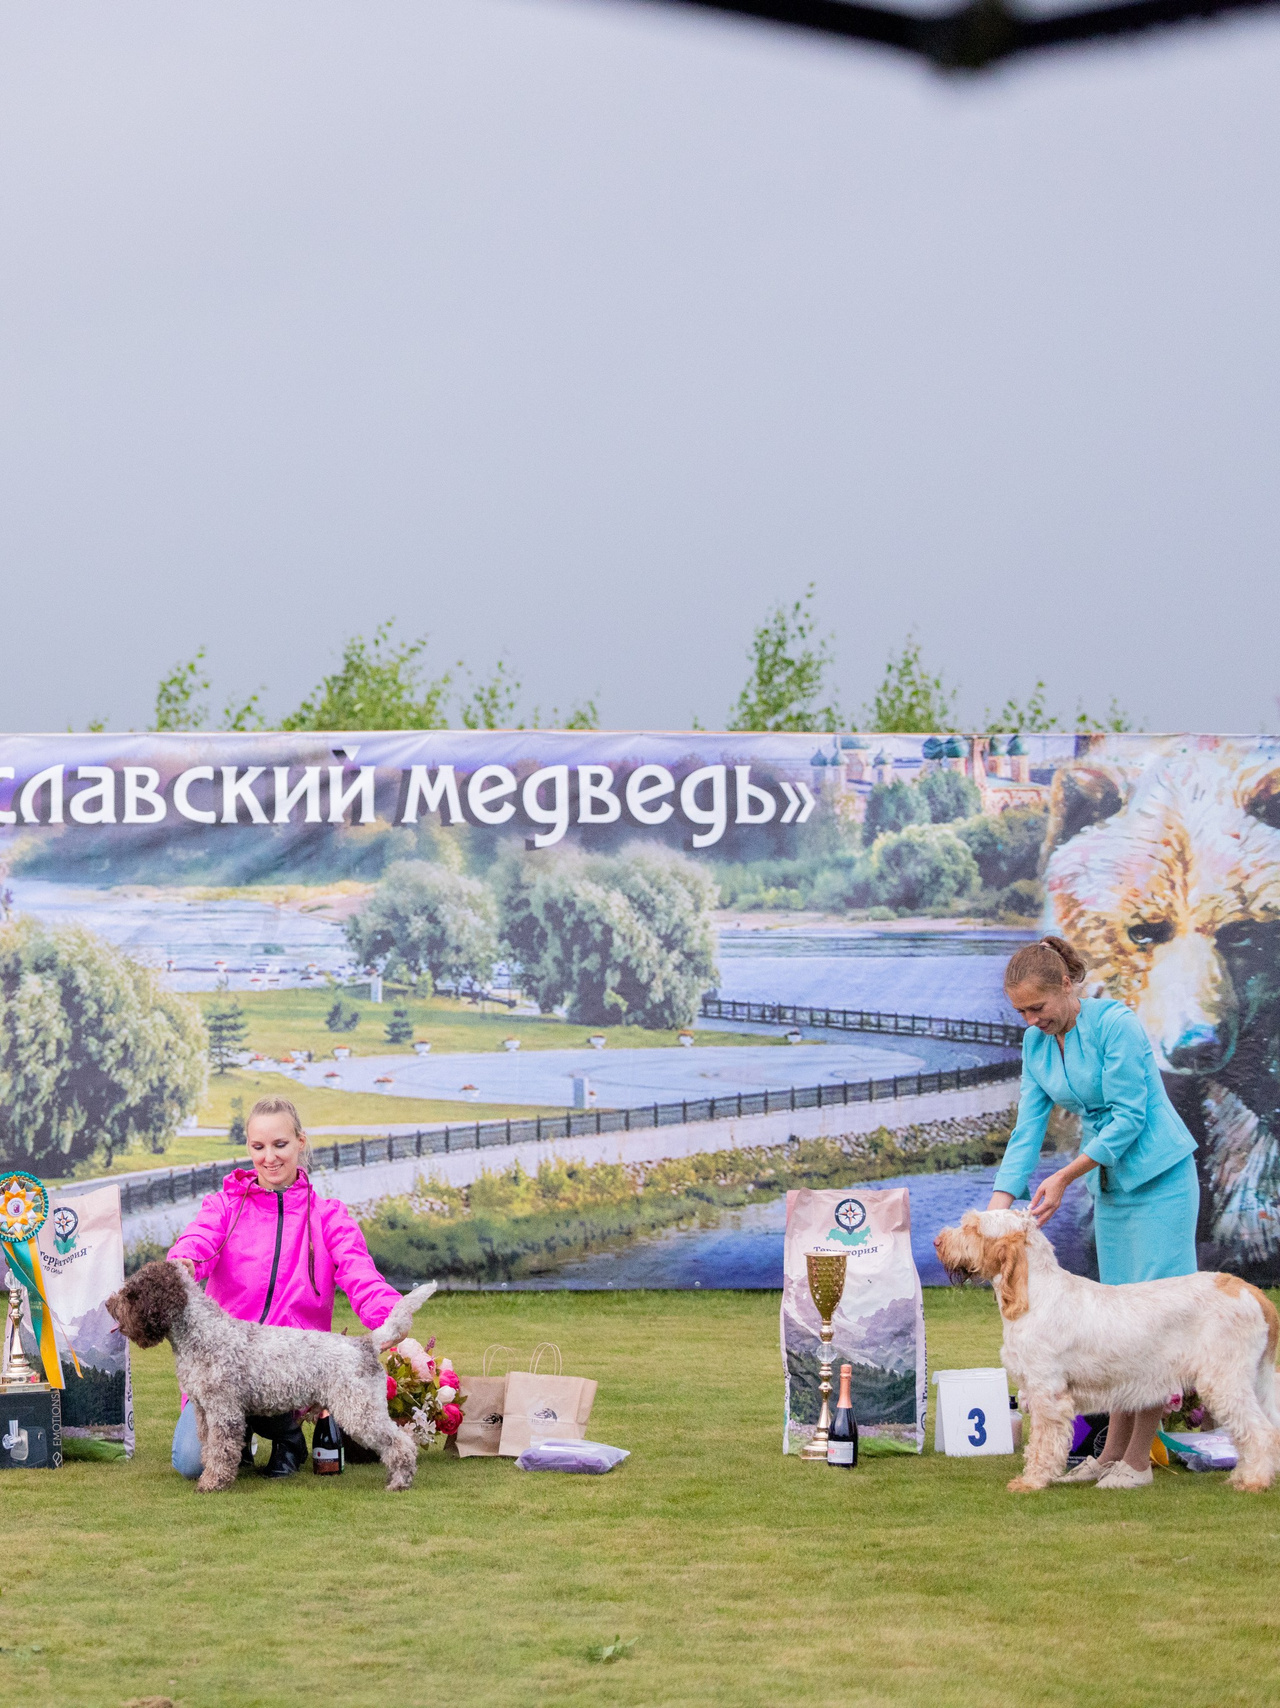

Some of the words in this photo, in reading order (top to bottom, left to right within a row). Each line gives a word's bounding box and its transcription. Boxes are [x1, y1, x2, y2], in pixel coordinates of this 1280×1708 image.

[401, 764, 817, 849] медведь»
[50, 1392, 61, 1446] EMOTIONS
[967, 1407, 988, 1447] 3
